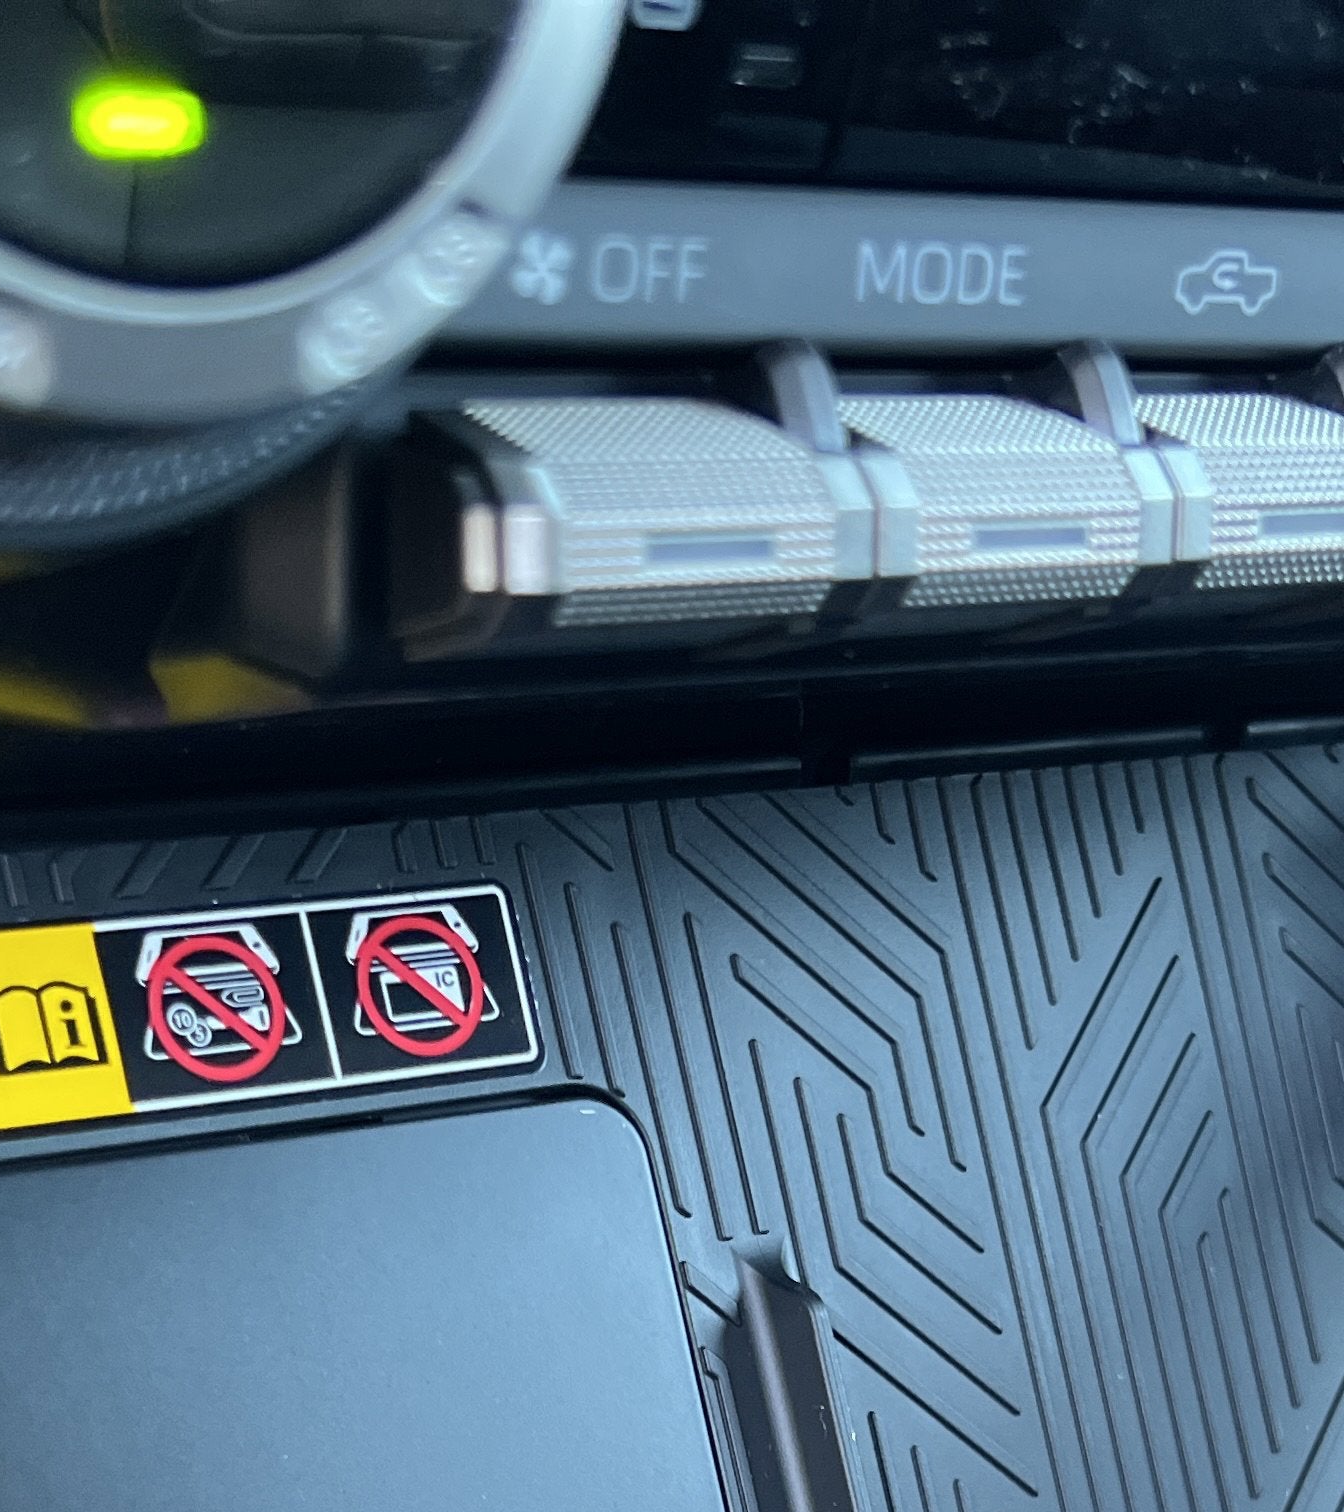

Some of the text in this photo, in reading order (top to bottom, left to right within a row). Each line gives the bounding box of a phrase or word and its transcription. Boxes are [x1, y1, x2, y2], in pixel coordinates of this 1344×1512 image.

[590, 233, 709, 303] OFF
[856, 240, 1030, 307] MODE
[433, 970, 455, 988] IC
